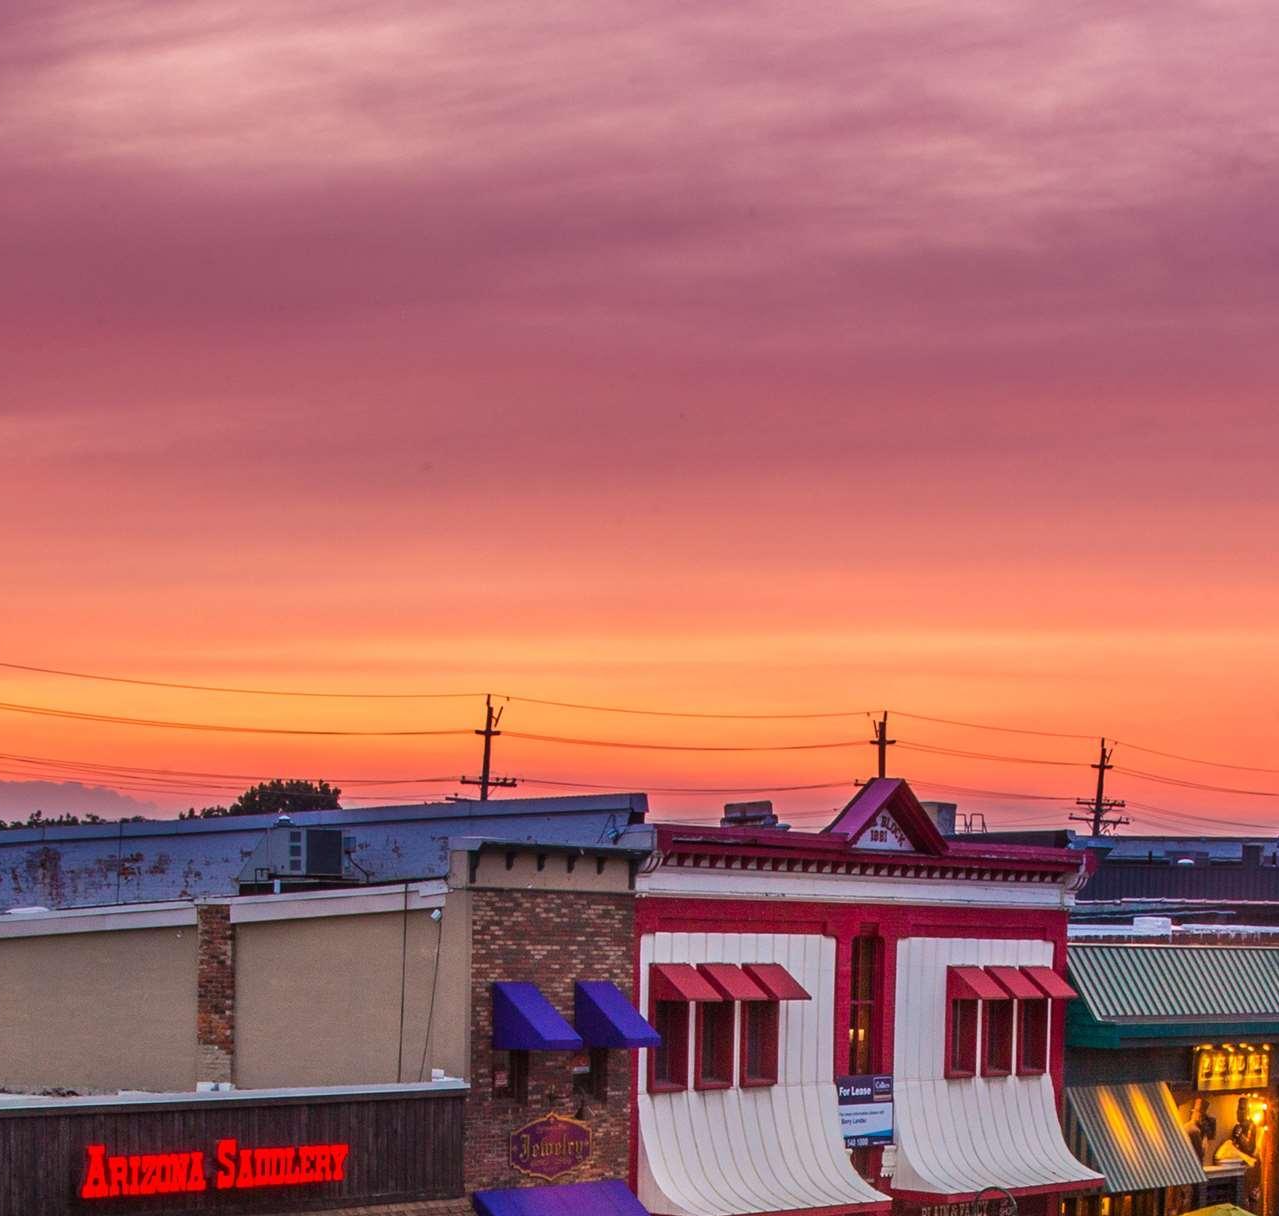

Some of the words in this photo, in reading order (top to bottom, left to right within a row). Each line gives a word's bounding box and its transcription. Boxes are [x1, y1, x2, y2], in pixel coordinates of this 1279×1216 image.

[839, 1087, 850, 1096] For
[851, 1086, 872, 1096] Lease
[519, 1133, 584, 1163] Jewelry
[81, 1143, 206, 1199] ARIZONA
[216, 1138, 350, 1189] SADDLERY
